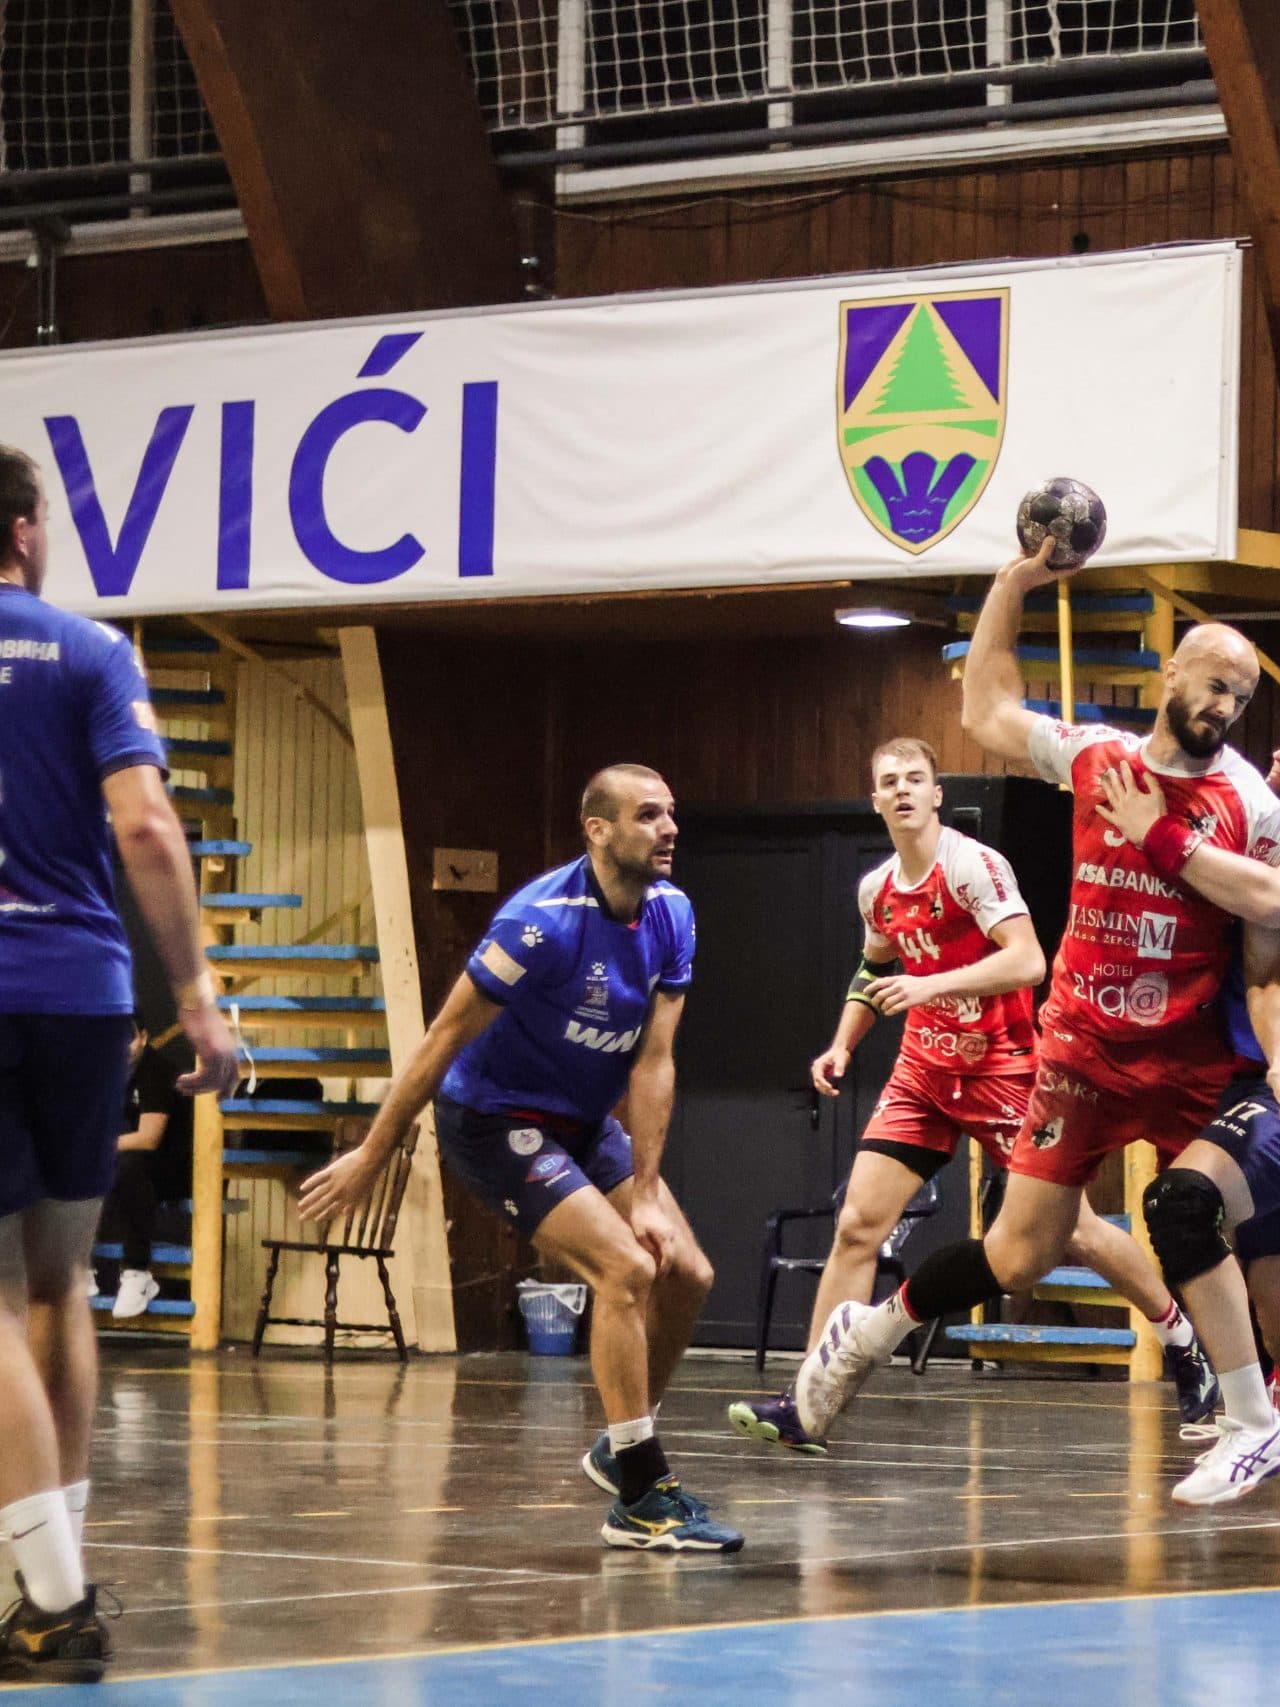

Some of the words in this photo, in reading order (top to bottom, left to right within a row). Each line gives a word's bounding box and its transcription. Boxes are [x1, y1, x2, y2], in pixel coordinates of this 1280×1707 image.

[43, 332, 499, 598] VIĆI
[0, 639, 60, 661] ВИНА
[897, 927, 941, 964] 44
[1223, 1101, 1269, 1122] 17
